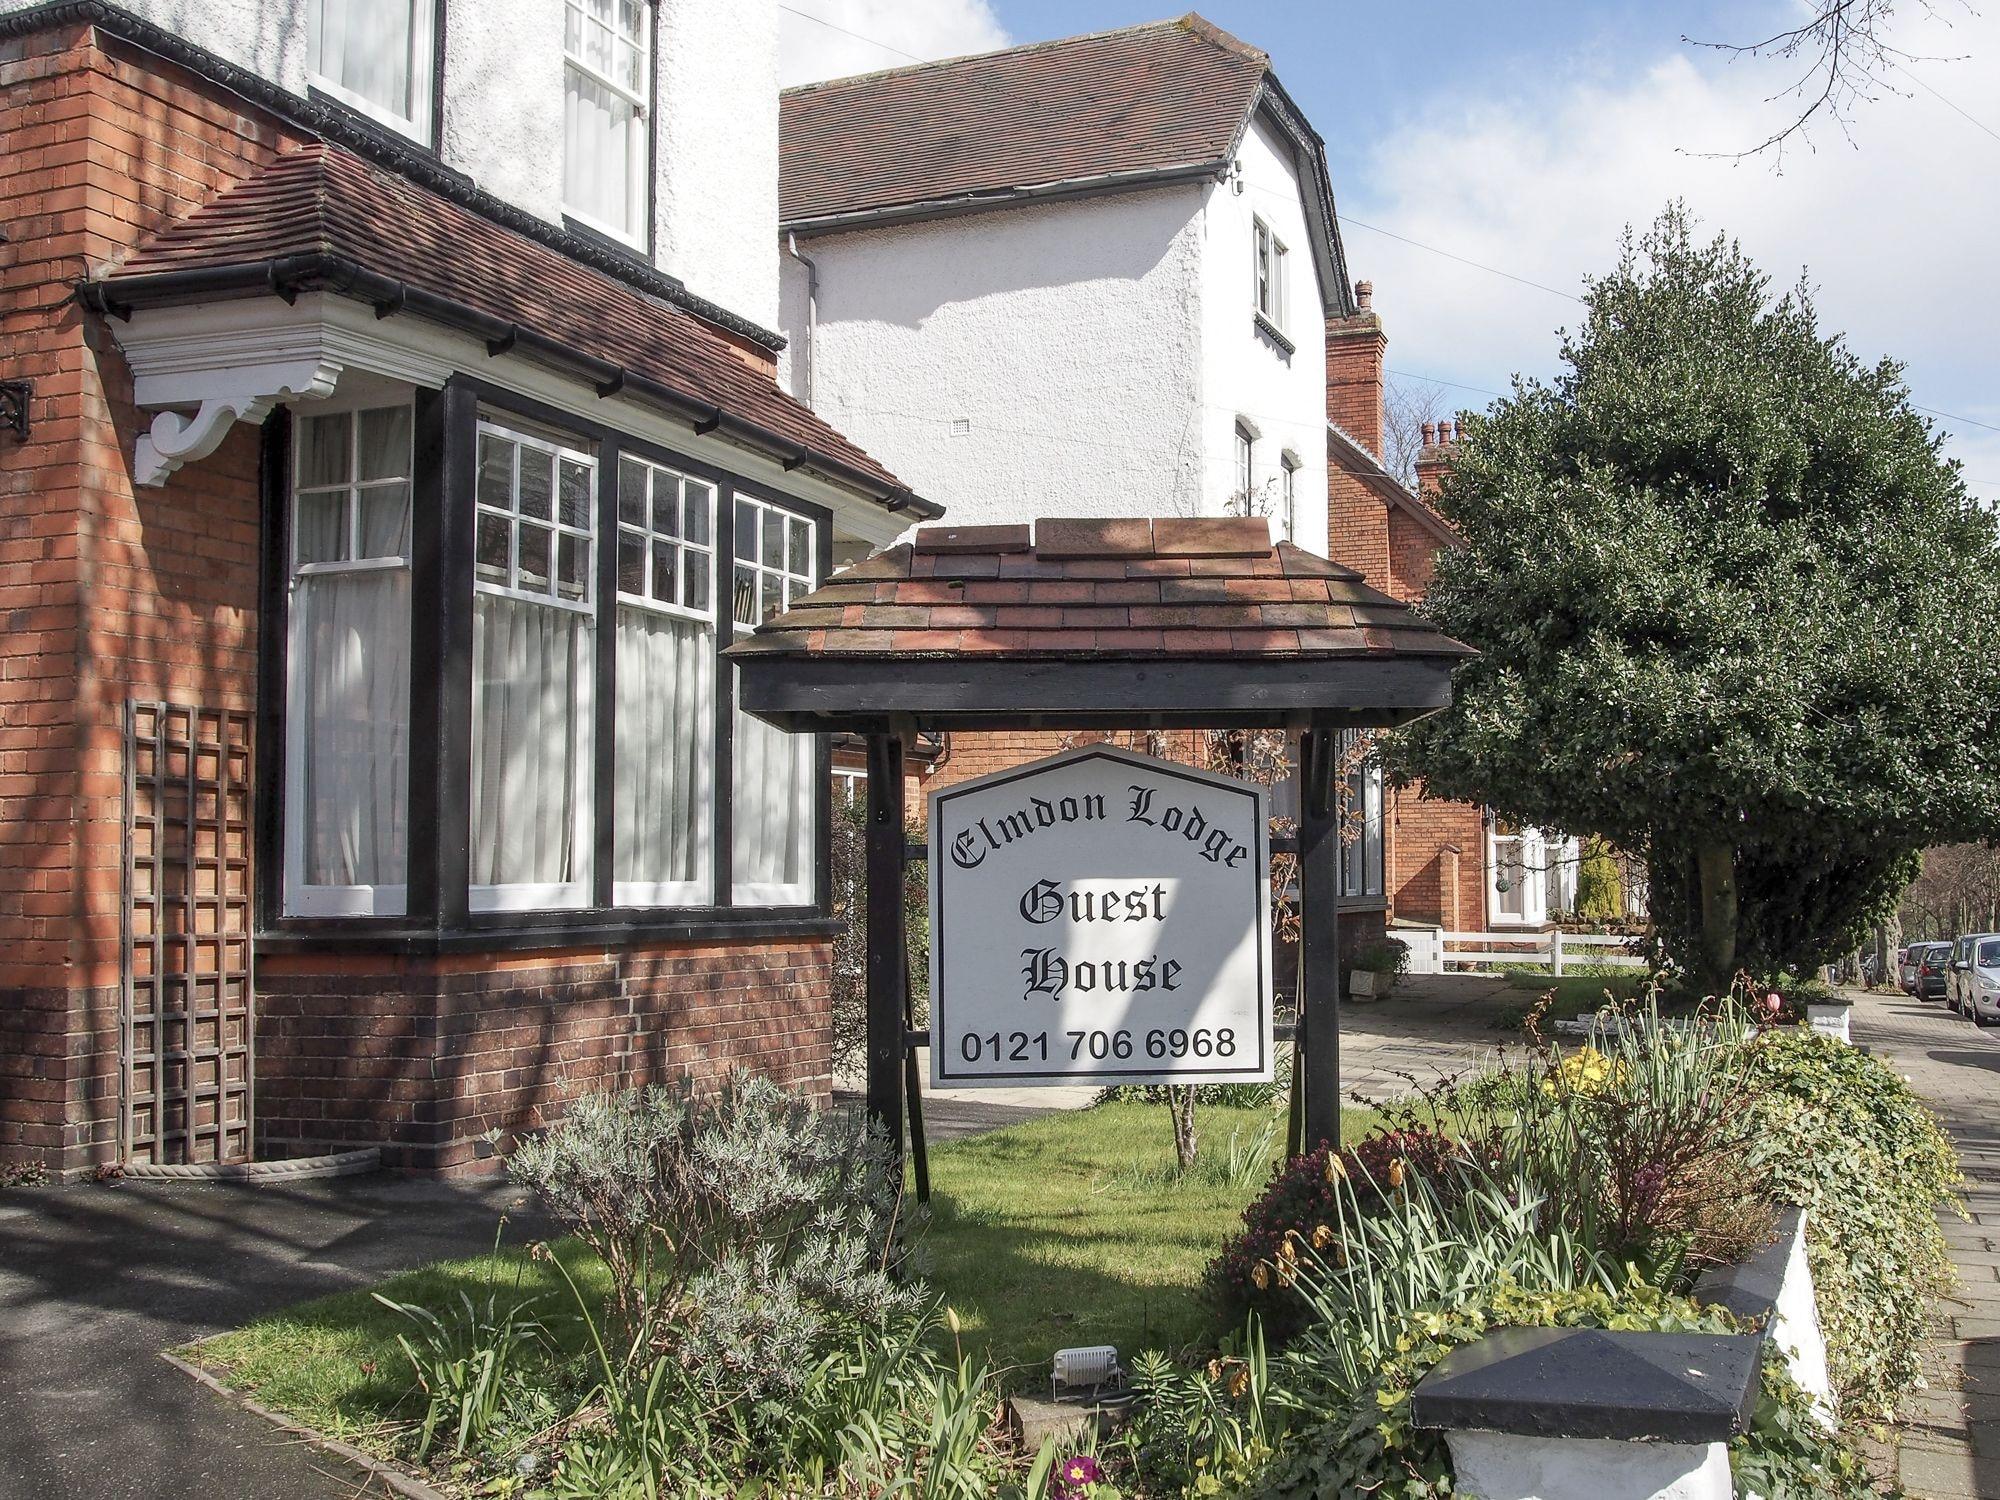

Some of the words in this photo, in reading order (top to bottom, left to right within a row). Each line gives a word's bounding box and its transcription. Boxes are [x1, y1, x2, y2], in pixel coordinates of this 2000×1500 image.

[950, 793, 1107, 868] Elmdon
[1126, 785, 1248, 868] Lodge
[1019, 878, 1167, 924] Guest
[1020, 947, 1183, 1001] House
[961, 1031, 1048, 1062] 0121
[1066, 1030, 1133, 1060] 706
[1145, 1028, 1236, 1059] 6968
